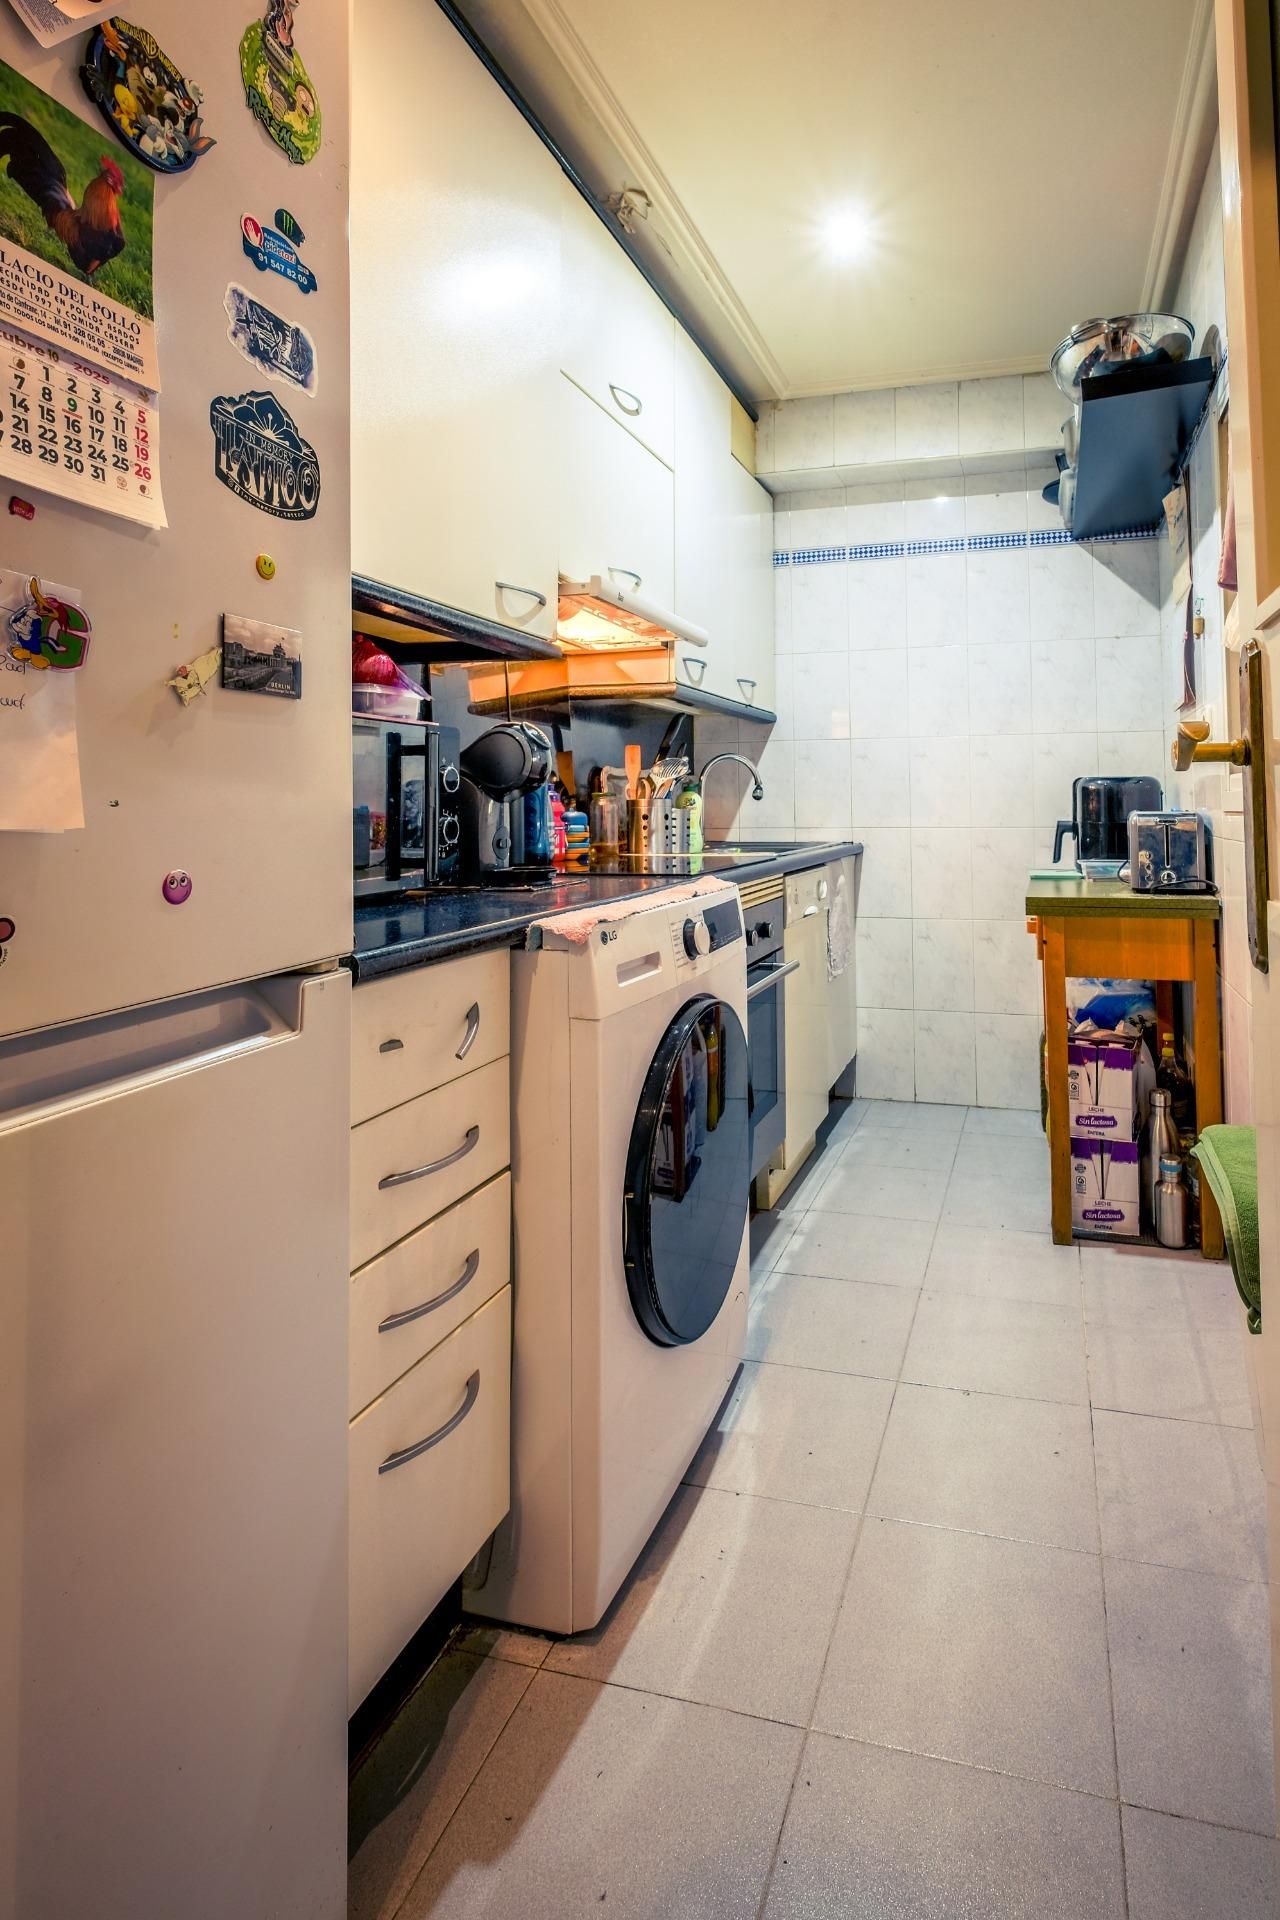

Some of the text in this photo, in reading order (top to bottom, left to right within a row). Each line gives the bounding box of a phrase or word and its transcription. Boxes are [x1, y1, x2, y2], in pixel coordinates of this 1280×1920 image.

[258, 252, 268, 265] 91
[270, 259, 285, 273] 547
[297, 274, 308, 285] 00
[13, 306, 34, 321] TODOS
[34, 317, 46, 327] LOS
[29, 291, 52, 308] 1997
[65, 311, 100, 333] COMIDA
[104, 330, 135, 351] CASERA
[54, 295, 66, 306] EN
[70, 303, 103, 326] POLLOS
[107, 323, 140, 345] ASADOS
[58, 281, 90, 309] DEL
[92, 300, 141, 335] POLLO
[0, 331, 45, 356] ubre
[47, 348, 59, 363] 10
[72, 362, 111, 385] 2025
[62, 320, 71, 331] 91
[73, 325, 86, 338] 328
[87, 333, 96, 343] 05
[96, 337, 106, 348] 05
[13, 373, 25, 390] 7
[41, 386, 53, 402] 8
[66, 397, 77, 412] 9
[88, 405, 105, 424] 10
[113, 416, 126, 434] 11
[134, 426, 149, 444] 12
[42, 366, 50, 382] 1
[67, 378, 77, 394] 2
[91, 387, 101, 404] 3
[114, 400, 125, 415] 4
[137, 409, 146, 424] 5
[9, 392, 30, 413] 14
[38, 403, 56, 424] 15
[64, 415, 81, 434] 16
[88, 425, 104, 443] 17
[112, 434, 128, 453] 18
[134, 444, 149, 461] 19
[11, 414, 29, 434] 21
[37, 425, 58, 445] 22
[63, 435, 83, 454] 23
[87, 444, 107, 464] 24
[112, 453, 130, 472] 25
[134, 462, 152, 481] 26
[245, 430, 294, 463] IN MEMORY
[10, 434, 33, 455] 28
[38, 444, 59, 464] 29
[63, 453, 84, 474] 30
[90, 463, 106, 482] 31
[270, 681, 291, 690] BERLIN
[1078, 1117, 1114, 1126] Sin lactosa
[1085, 1211, 1121, 1220] Sin lactosa
[1094, 1200, 1112, 1208] LECHE
